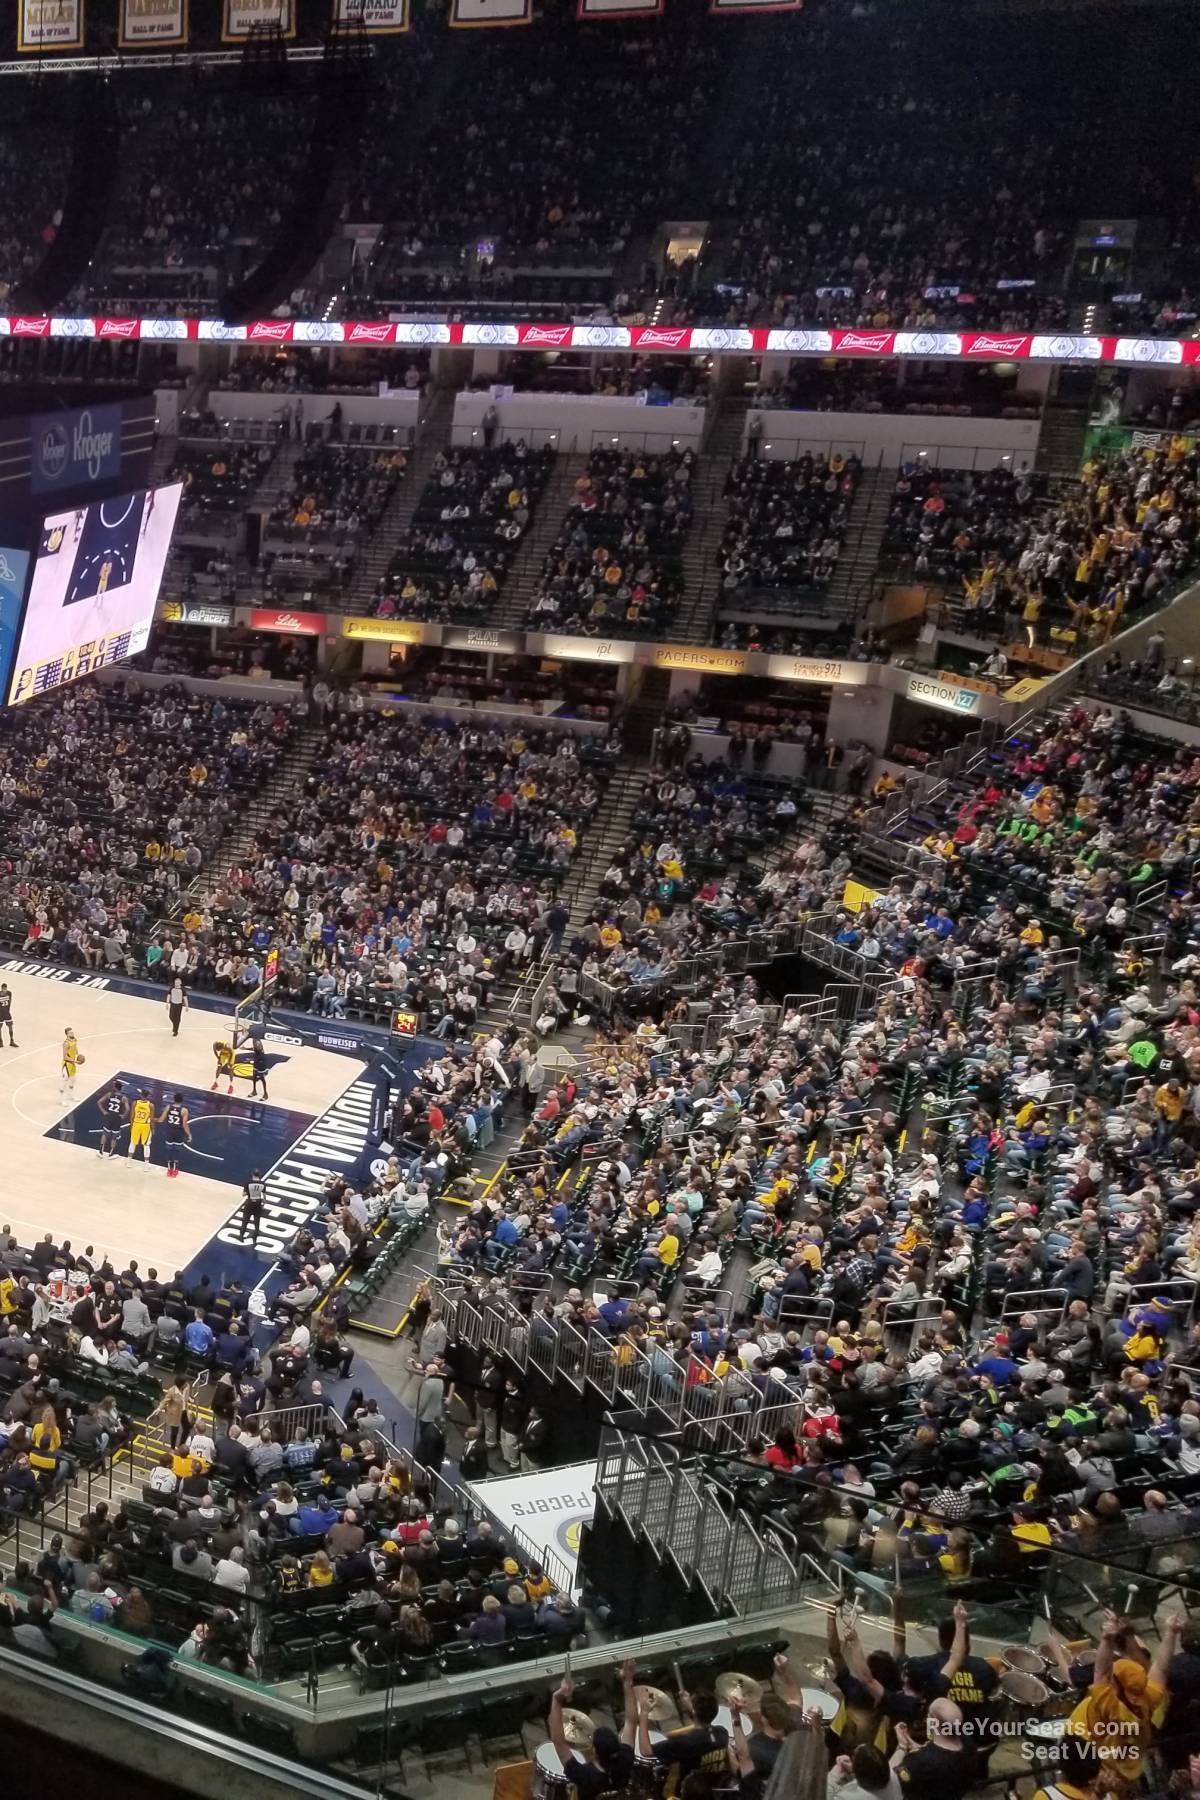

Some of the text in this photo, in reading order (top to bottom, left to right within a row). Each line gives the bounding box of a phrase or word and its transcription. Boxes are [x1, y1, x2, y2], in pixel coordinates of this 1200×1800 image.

[641, 331, 682, 345] Budweiser
[842, 334, 886, 348] Budweiser
[976, 337, 1021, 352] Budweiser
[73, 410, 114, 480] Kroger
[188, 609, 230, 624] @Pacers
[274, 613, 302, 631] Lilly
[824, 662, 842, 675] 97.1
[909, 680, 956, 702] SECTION
[0, 956, 72, 983] GROW
[71, 972, 111, 990] WE
[264, 1032, 303, 1046] GEICO
[318, 1035, 357, 1048] BUDWEISER
[108, 1102, 120, 1113] 22
[167, 1115, 180, 1125] 32
[292, 1080, 377, 1164] INDIANA
[511, 1491, 591, 1516] Pacers
